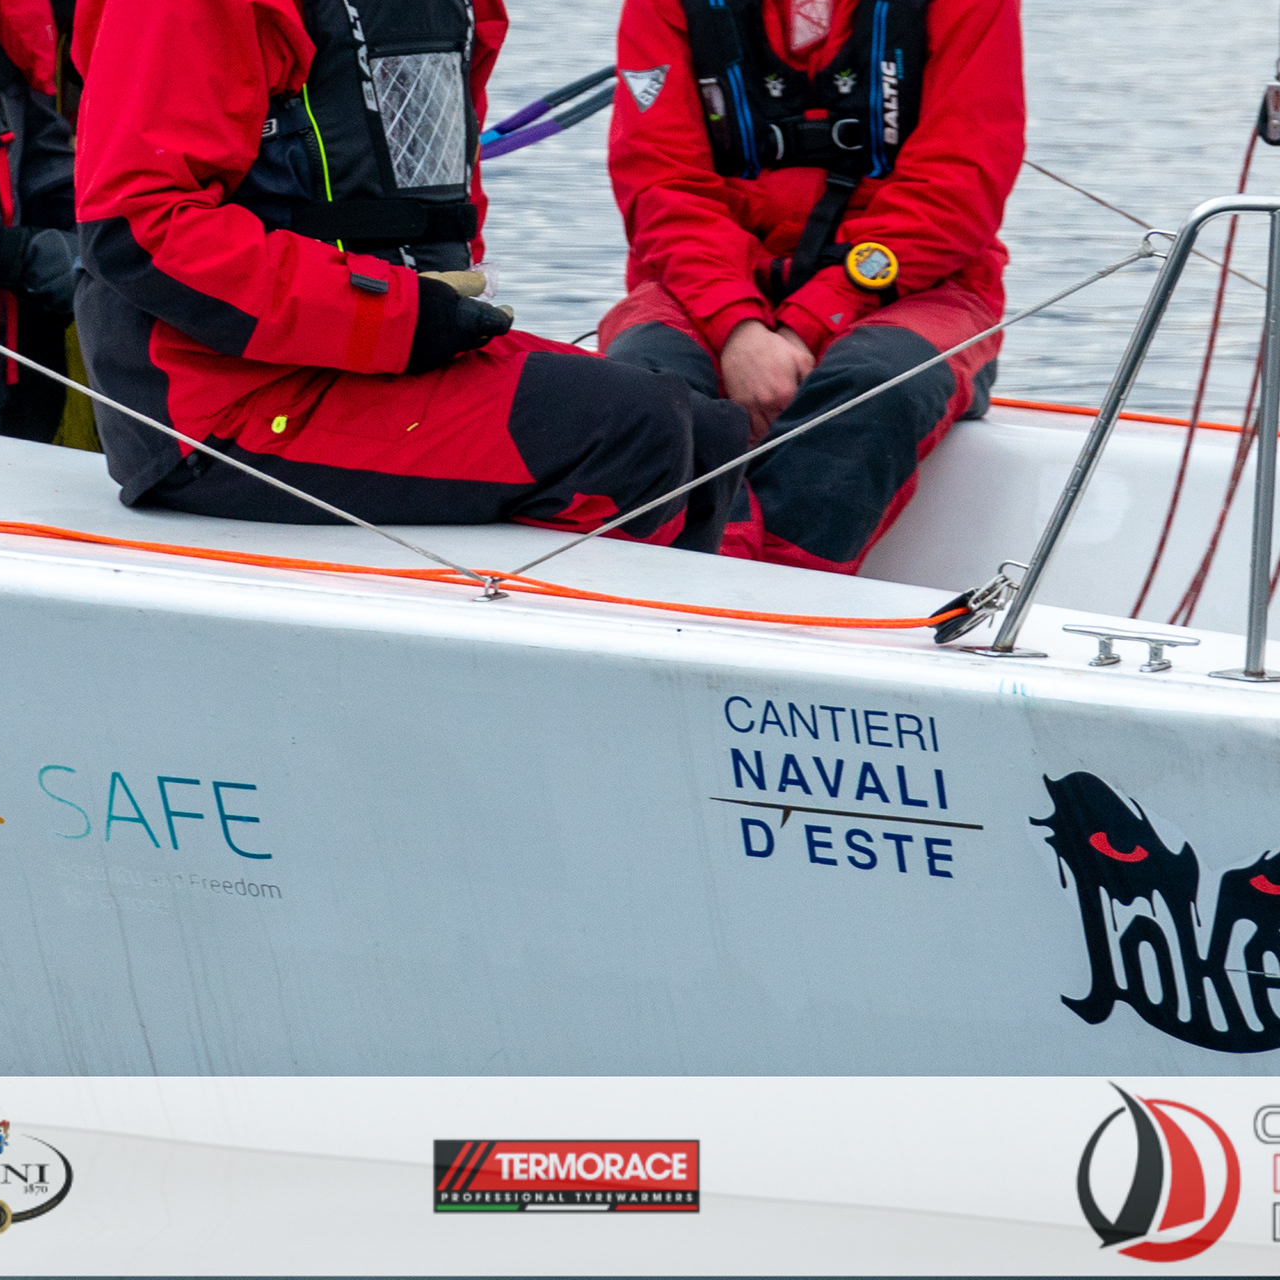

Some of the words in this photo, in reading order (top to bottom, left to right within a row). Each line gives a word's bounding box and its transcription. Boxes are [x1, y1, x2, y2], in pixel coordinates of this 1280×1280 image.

[879, 60, 900, 145] BALTIC
[724, 695, 940, 752] CANTIERI
[730, 747, 949, 810] NAVALI
[37, 764, 273, 861] SAFE
[188, 872, 283, 900] Freedom
